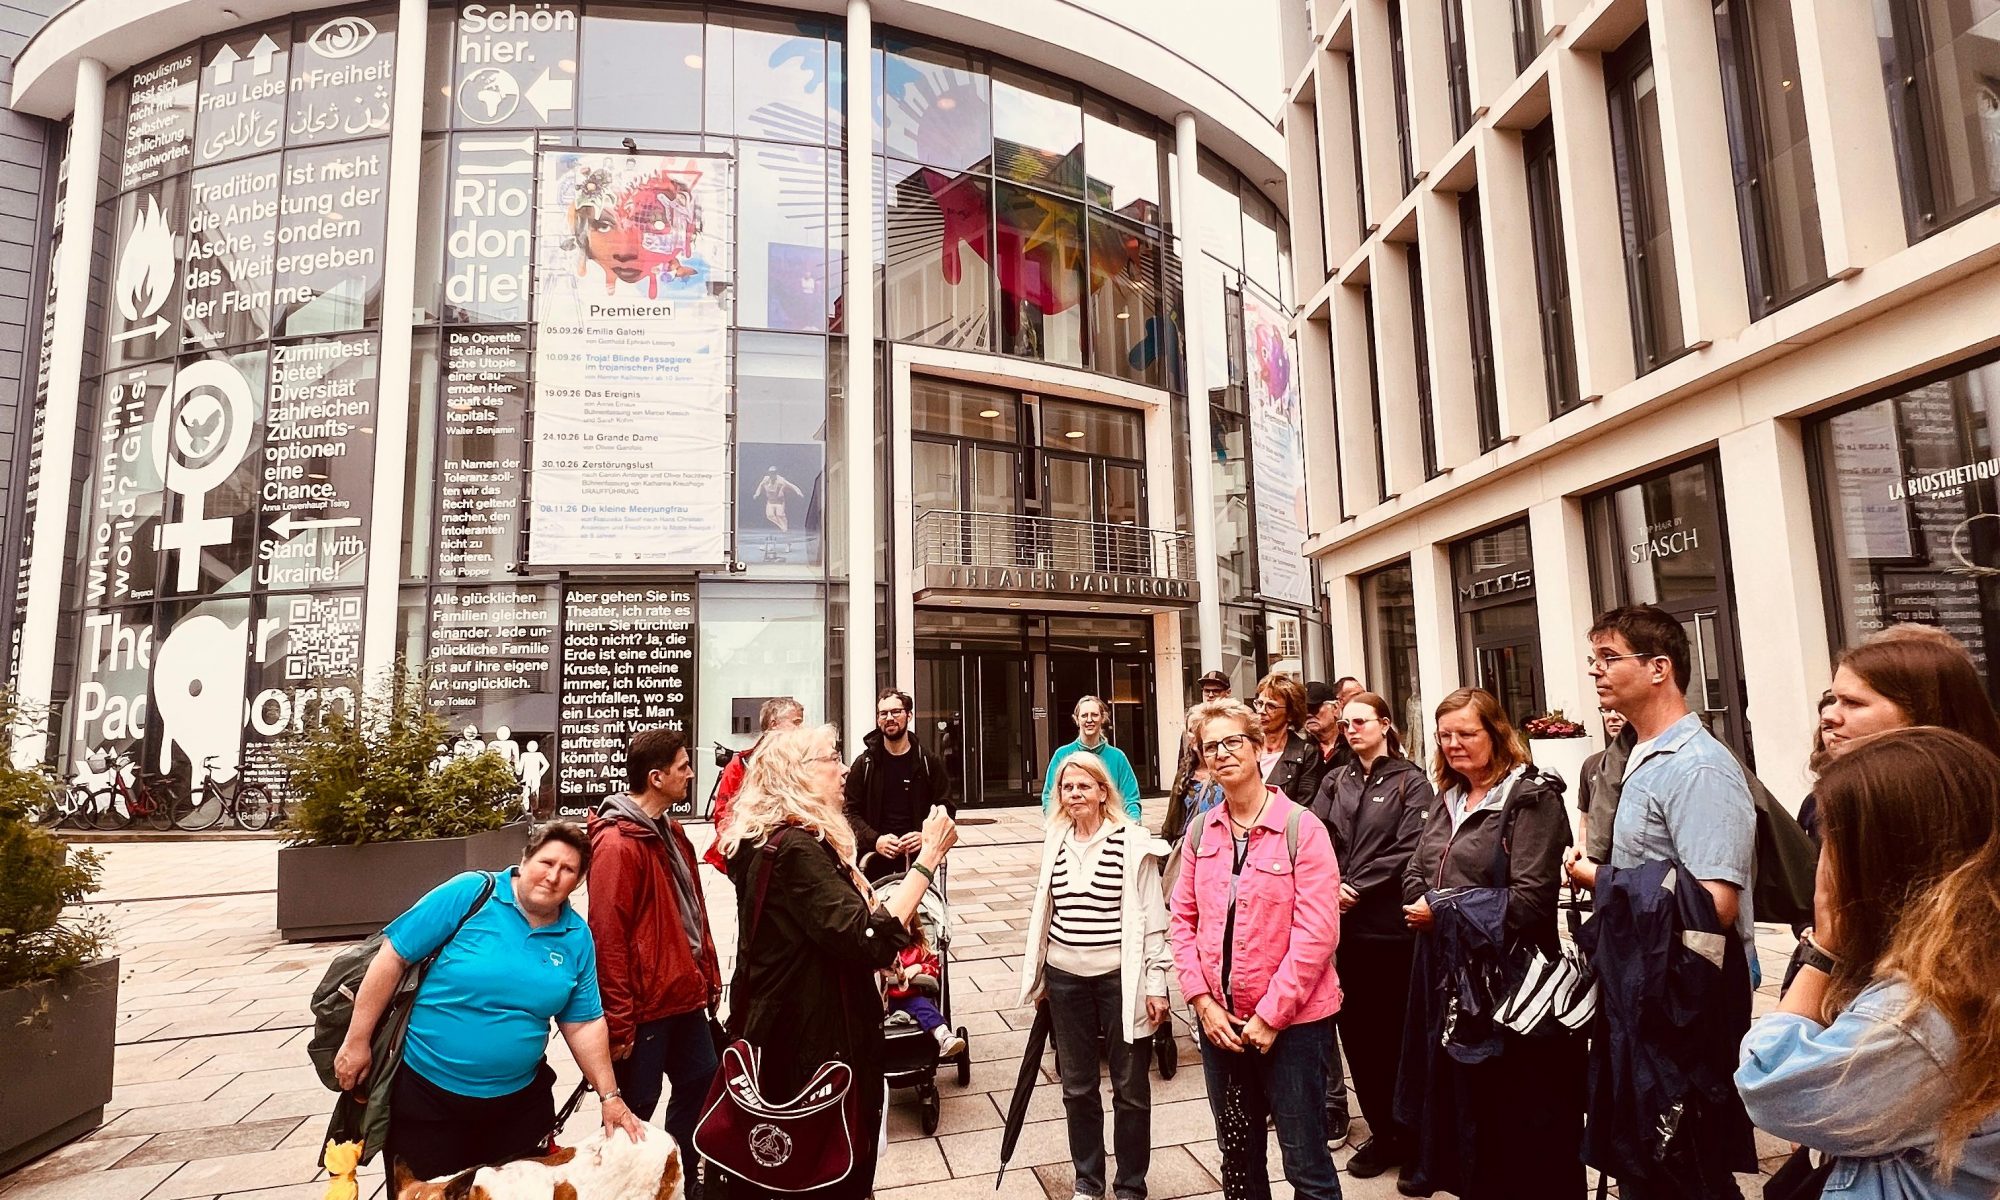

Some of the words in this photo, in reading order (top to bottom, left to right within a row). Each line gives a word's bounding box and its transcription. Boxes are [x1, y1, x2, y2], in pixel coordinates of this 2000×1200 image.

[460, 4, 575, 33] Schön
[460, 35, 534, 63] hier.
[133, 56, 192, 88] Populismus
[131, 86, 155, 105] lässt
[158, 77, 178, 95] sich
[199, 92, 236, 112] Frau
[243, 76, 303, 102] Leben
[310, 60, 391, 89] Freiheit
[130, 103, 154, 123] nicht
[156, 95, 172, 110] mit
[128, 114, 179, 140] Selbstver-
[126, 128, 185, 158] schlichtung
[125, 144, 190, 176] beantworten.
[193, 172, 277, 205] Tradition
[287, 164, 313, 186] ist
[321, 155, 379, 181] nicht
[454, 179, 533, 217] Rio
[190, 210, 220, 234] die
[225, 192, 333, 226] Anbetung
[340, 186, 380, 208] der
[186, 234, 256, 262] Asche,
[263, 219, 360, 246] sondern
[185, 268, 221, 290] das
[229, 246, 374, 282] Weitergeben
[182, 298, 216, 321] der
[222, 285, 317, 313] Flamme.
[590, 305, 671, 317] Premieren
[450, 333, 469, 343] Die
[472, 333, 521, 345] Operette
[617, 328, 645, 336] Galotti
[272, 339, 370, 364] Zumindest
[450, 346, 463, 356] ist
[465, 346, 483, 356] die
[486, 346, 514, 356] ironi-
[449, 359, 476, 369] sche
[479, 359, 516, 370] Utopie
[586, 354, 610, 363] Troja!
[643, 355, 692, 364] Passagiere
[272, 363, 323, 384] bietet
[600, 364, 653, 372] trojanischen
[270, 379, 355, 402] Diversität
[546, 390, 580, 398] 19.09.26
[585, 390, 601, 398] Das
[605, 391, 640, 399] Ereignis
[103, 384, 124, 444] the
[122, 369, 147, 462] Girls!
[268, 400, 369, 422] zahlreichen
[447, 410, 498, 423] Kapitals.
[267, 422, 355, 441] Zukunfts-
[446, 426, 473, 435] Walter
[476, 426, 515, 436] Benjamin
[265, 441, 346, 464] optionen
[444, 460, 458, 469] Im
[462, 460, 499, 469] Namen
[502, 459, 520, 468] der
[582, 461, 653, 470] Zerstörungslust
[265, 465, 303, 481] eine
[444, 473, 488, 483] Toleranz
[491, 472, 514, 482] soll-
[100, 453, 117, 509] run
[263, 483, 336, 501] Chance.
[1889, 482, 1905, 500] LA
[1932, 487, 1963, 500] PARIS
[330, 499, 350, 509] Tsing
[443, 499, 473, 510] Recht
[476, 499, 516, 511] geltend
[630, 505, 688, 514] Meerjungfrau
[442, 513, 487, 523] machen,
[490, 512, 510, 522] den
[114, 479, 137, 597] world?
[259, 538, 320, 560] Stand
[323, 536, 364, 556] with
[1630, 528, 1698, 564] STASCH
[87, 522, 111, 600] Who
[258, 561, 340, 584] Ukraine!
[439, 567, 456, 576] Karl
[458, 567, 489, 578] Popper
[950, 570, 1055, 589] THEATER
[1070, 573, 1189, 597] PADERBORN
[434, 593, 458, 605] Alle
[462, 592, 536, 607] glücklichen
[566, 591, 597, 602] Aber
[601, 592, 642, 604] gehen
[646, 591, 666, 602] Sie
[670, 591, 690, 602] ins
[434, 610, 488, 622] Familien
[492, 610, 547, 623] gleichen
[566, 606, 619, 619] Theater,
[623, 605, 642, 616] ich
[647, 606, 671, 616] rate
[675, 607, 690, 616] es
[432, 627, 492, 639] einander.
[496, 626, 526, 638] Jede
[530, 627, 552, 637] un-
[566, 620, 605, 631] Ihnen.
[609, 620, 630, 631] Sie
[634, 620, 688, 630] fürchten
[565, 635, 597, 646] doch
[602, 634, 642, 645] nicht?
[645, 634, 662, 647] Ja,
[666, 633, 686, 645] die
[431, 644, 497, 658] glückliche
[502, 643, 549, 654] Familie
[565, 649, 595, 660] Erde
[600, 649, 616, 660] ist
[619, 649, 646, 659] eine
[651, 648, 691, 659] dünne
[431, 662, 447, 673] ist
[450, 661, 471, 673] auf
[476, 661, 500, 672] ihre
[504, 661, 548, 673] eigene
[565, 664, 610, 676] Kruste,
[615, 663, 634, 674] ich
[638, 663, 678, 673] meine
[429, 679, 449, 691] Art
[453, 677, 530, 691] unglücklich.
[564, 679, 609, 691] immer,
[613, 678, 632, 689] ich
[637, 676, 682, 688] könnte
[429, 698, 444, 706] Leo
[448, 697, 476, 706] Tolstoi
[563, 708, 583, 719] ein
[587, 707, 619, 719] Loch
[623, 707, 642, 718] ist.
[646, 706, 674, 717] Man
